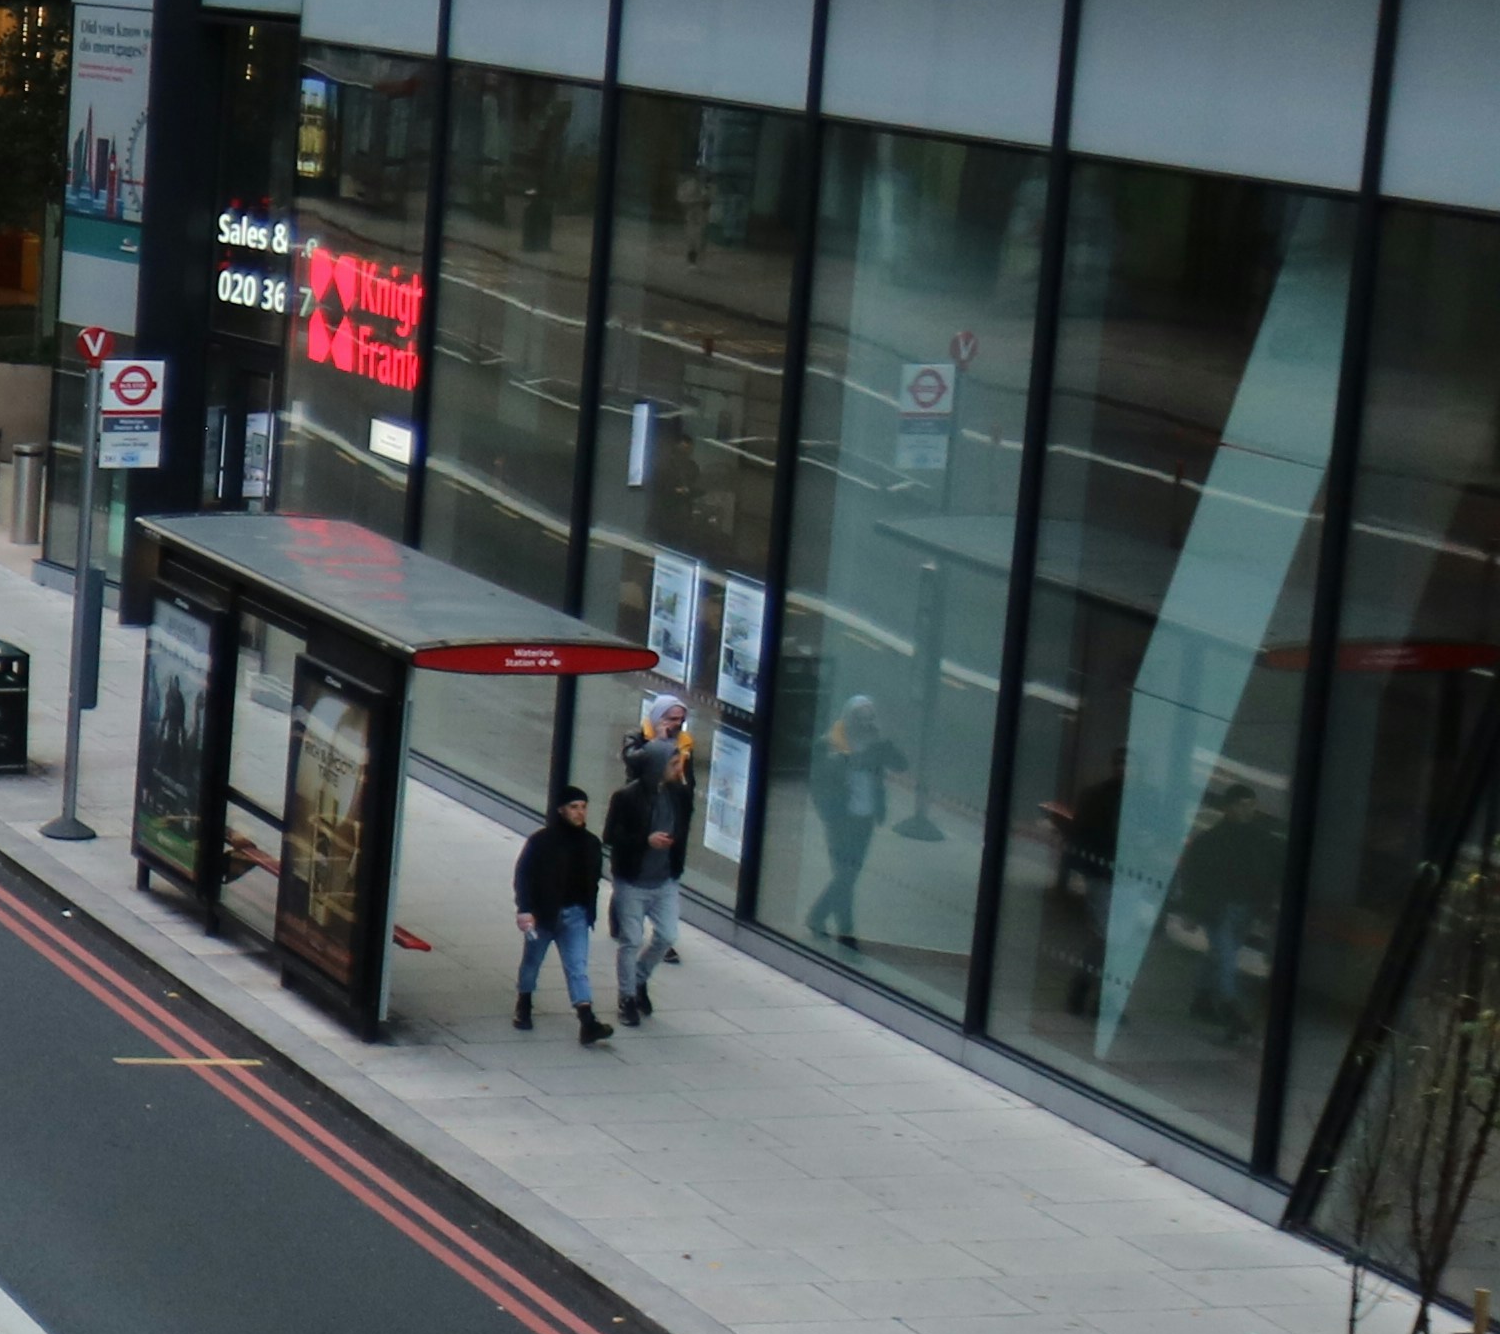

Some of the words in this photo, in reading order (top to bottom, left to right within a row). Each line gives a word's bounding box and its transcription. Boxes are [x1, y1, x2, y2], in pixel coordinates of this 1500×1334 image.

[217, 213, 268, 251] Sales
[272, 223, 288, 254] &
[217, 270, 257, 307] 020
[82, 331, 105, 357] V
[358, 325, 419, 391] Frank
[504, 657, 536, 667] Station
[513, 648, 555, 657] Waterloo
